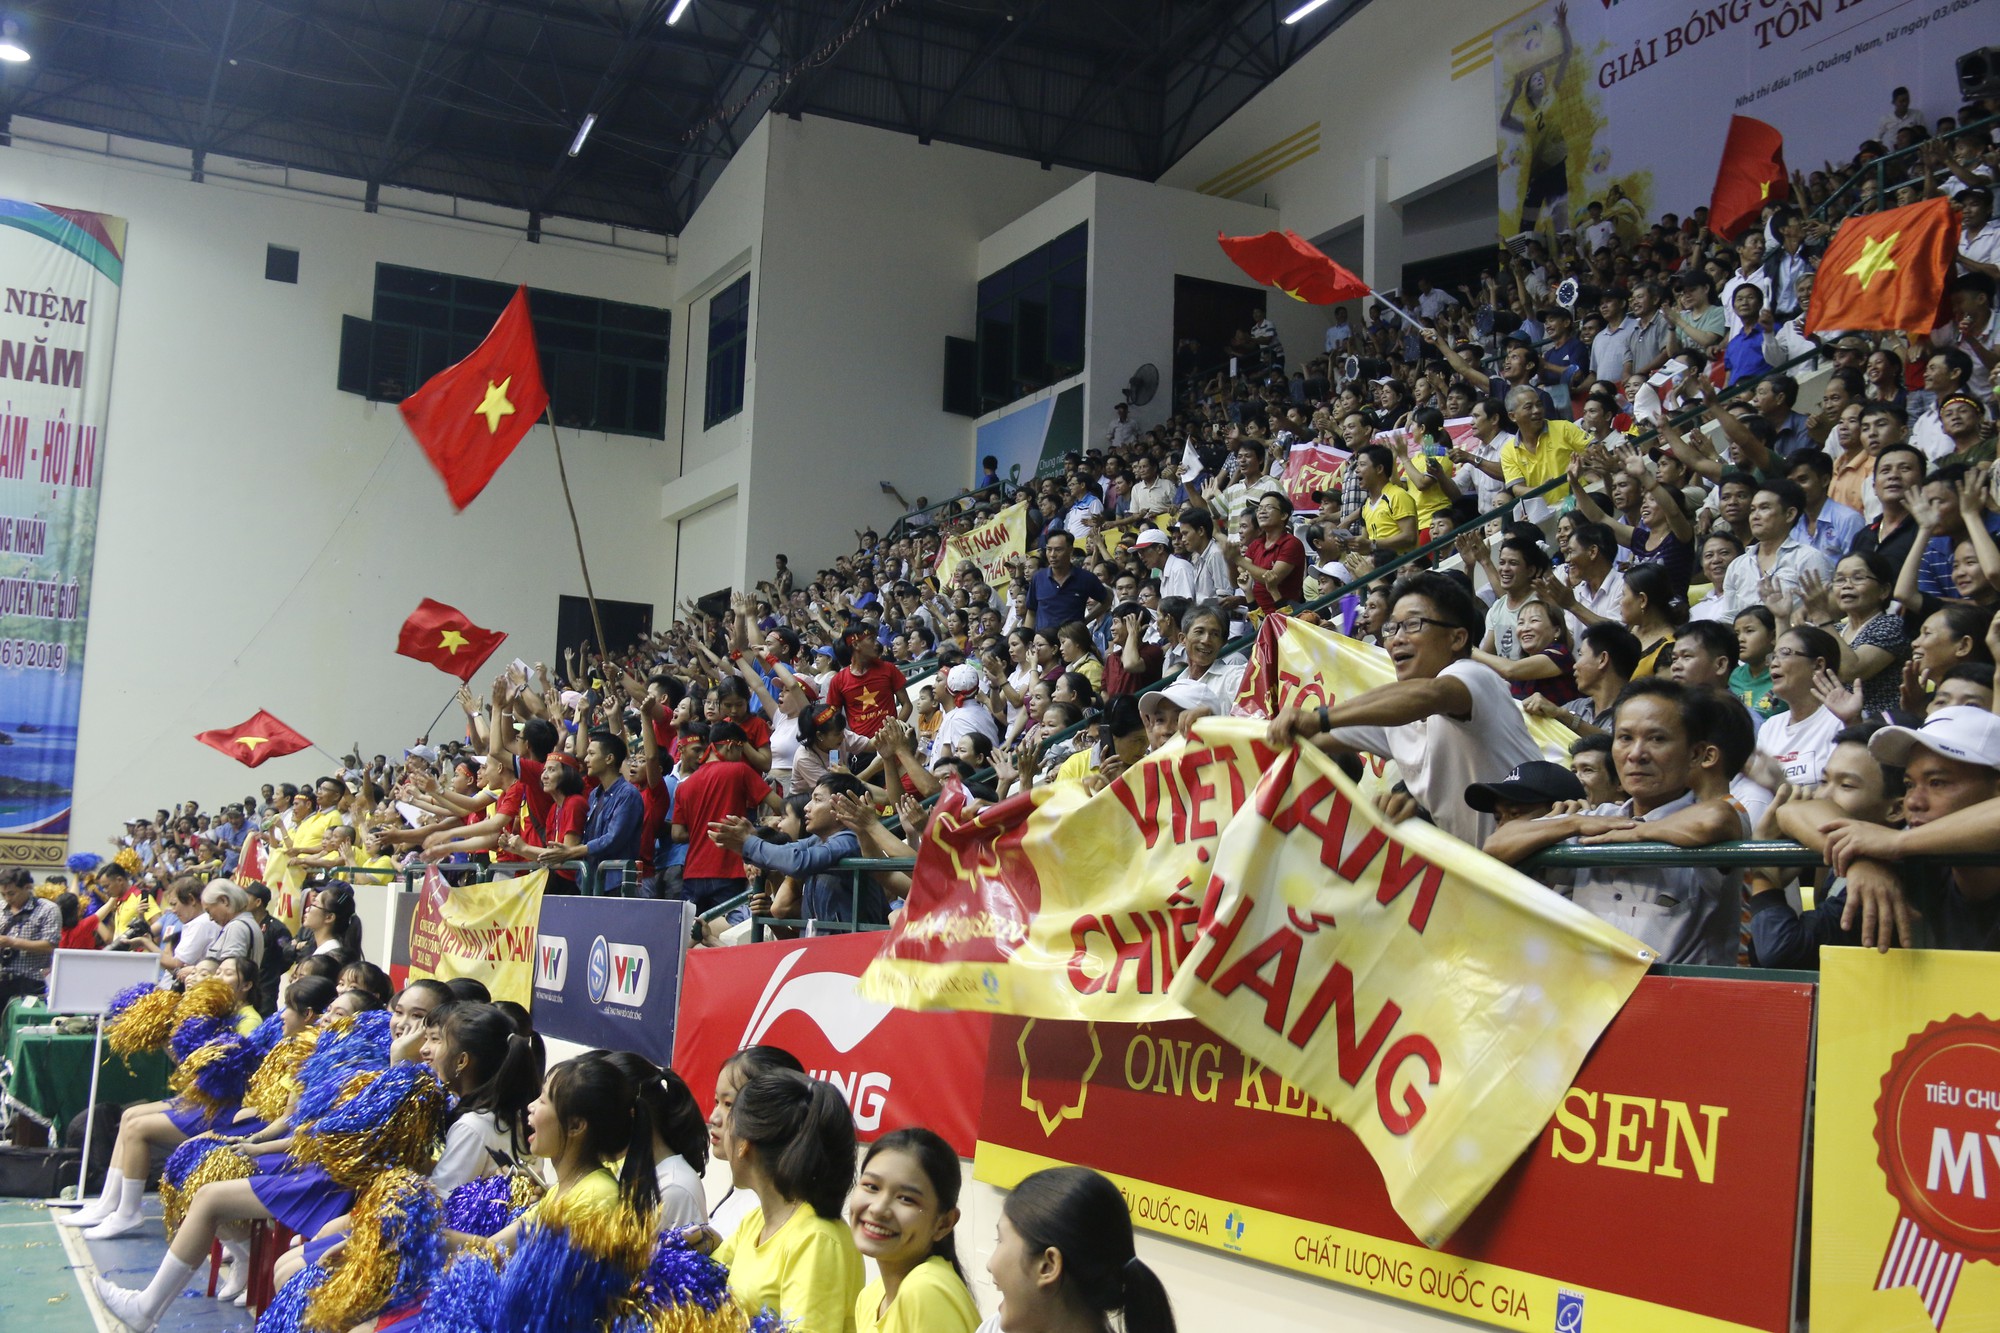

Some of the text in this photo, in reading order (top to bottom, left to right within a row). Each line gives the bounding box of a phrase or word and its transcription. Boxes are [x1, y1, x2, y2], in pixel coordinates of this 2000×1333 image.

[1598, 0, 1750, 89] GIẢI BÓNG
[1754, 0, 1823, 49] TÔN
[1816, 50, 1852, 72] Quảng
[1900, 16, 1930, 36] ngày
[4, 287, 87, 328] NIỆM
[0, 336, 84, 389] NĂM
[0, 400, 29, 480] ÀM
[40, 408, 71, 499] HỘI
[71, 425, 97, 488] AN
[973, 523, 1010, 552] NAM
[1111, 730, 1246, 862] VIỆT
[542, 946, 562, 980] VTV
[615, 955, 643, 995] VTV
[1067, 874, 1442, 1138] CHIẾ HẮNG
[1925, 1081, 1960, 1106] TIÊU
[1551, 1087, 1729, 1184] SEN
[1138, 1196, 1181, 1227] QUỐC
[1184, 1208, 1209, 1235] GIA
[1294, 1234, 1530, 1321] CHẤT LƯỢNG QUỐC GIA
